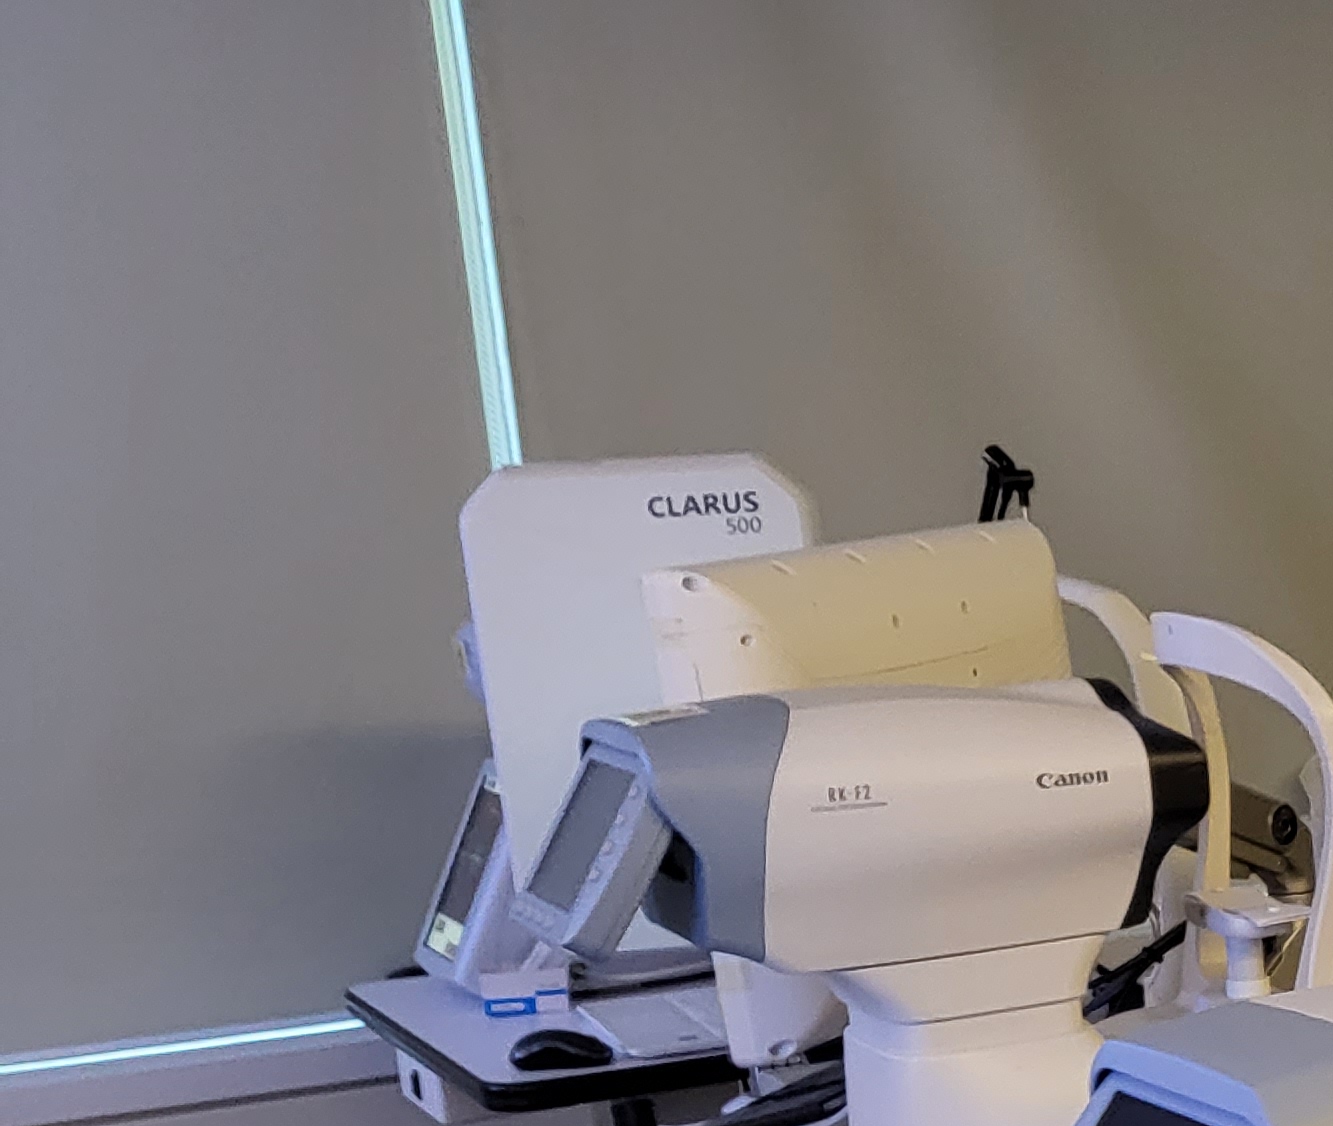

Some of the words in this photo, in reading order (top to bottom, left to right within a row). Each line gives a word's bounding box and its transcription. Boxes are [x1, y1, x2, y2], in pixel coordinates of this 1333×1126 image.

[647, 490, 760, 518] CLARUS
[726, 516, 762, 535] 500
[1036, 770, 1109, 790] Canon
